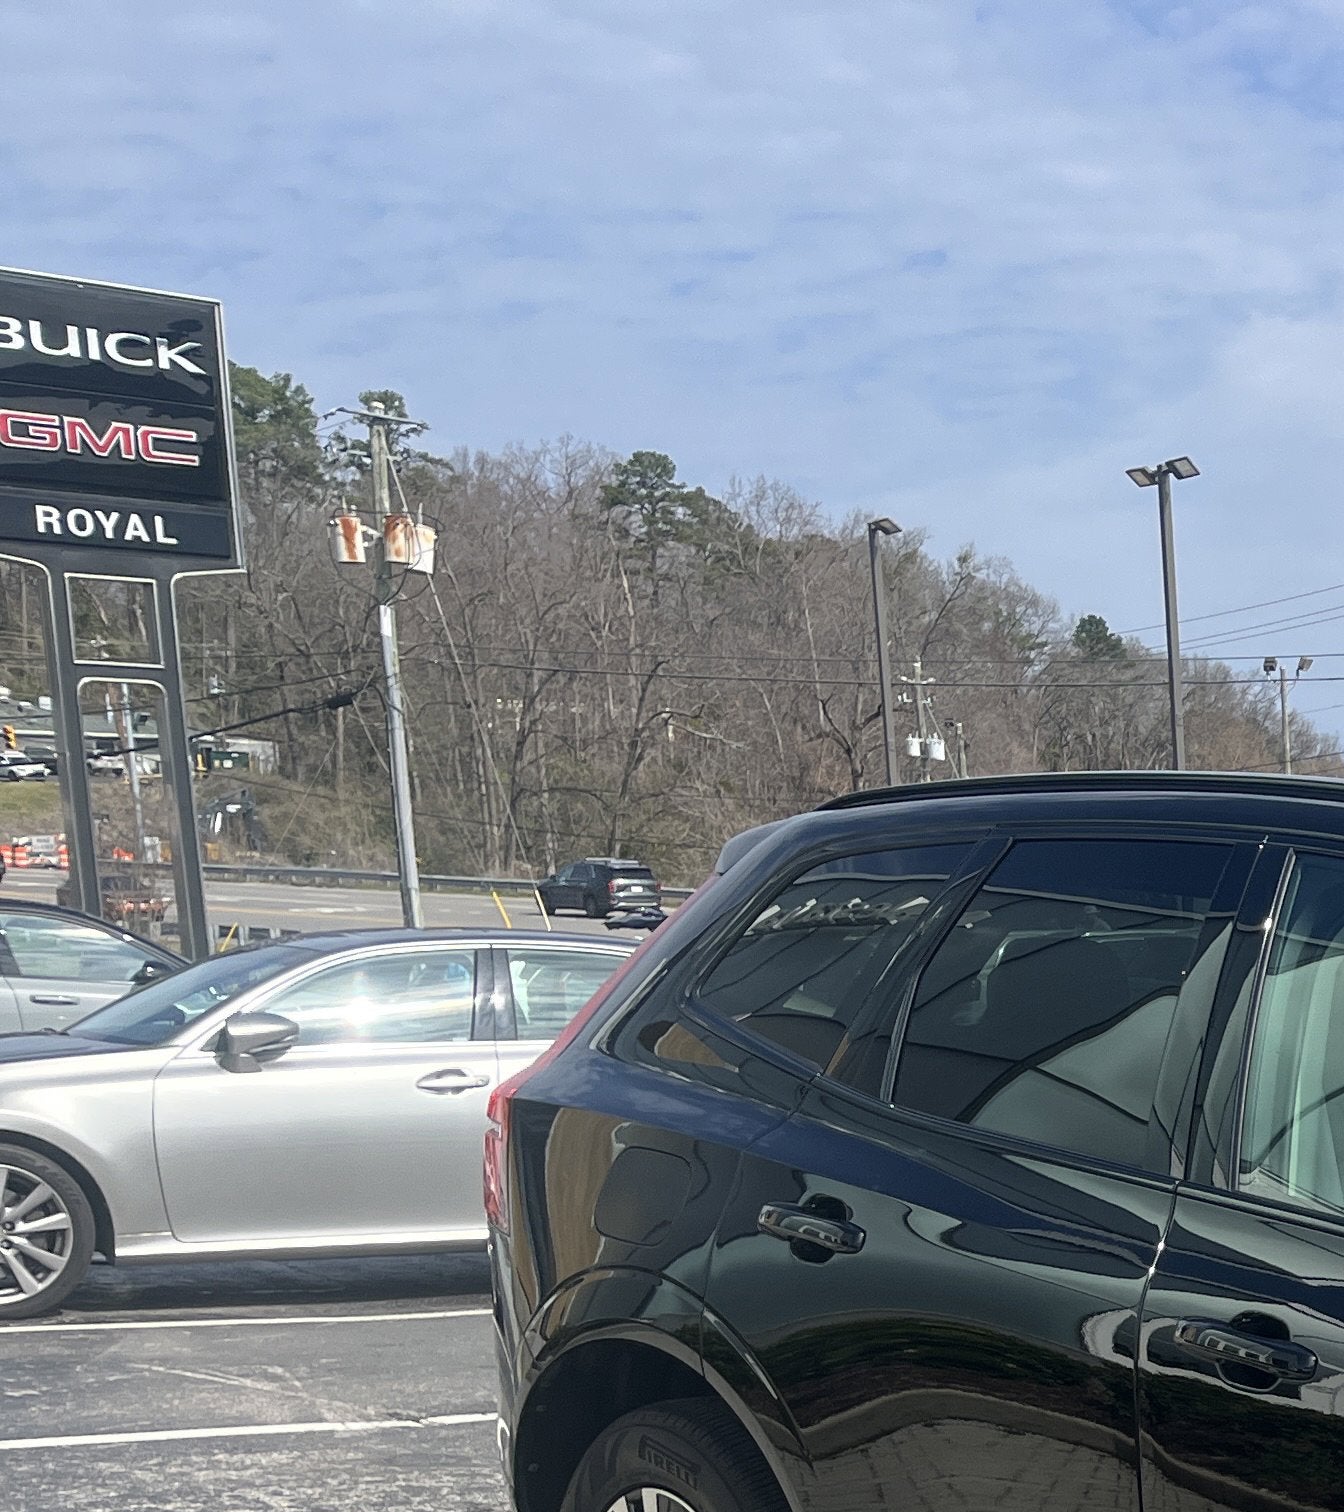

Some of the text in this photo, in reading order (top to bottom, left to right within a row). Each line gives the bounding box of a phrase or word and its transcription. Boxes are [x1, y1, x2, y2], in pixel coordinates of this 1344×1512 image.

[0, 316, 206, 375] BUICK
[0, 409, 200, 467] GMC
[35, 504, 179, 545] ROYAL
